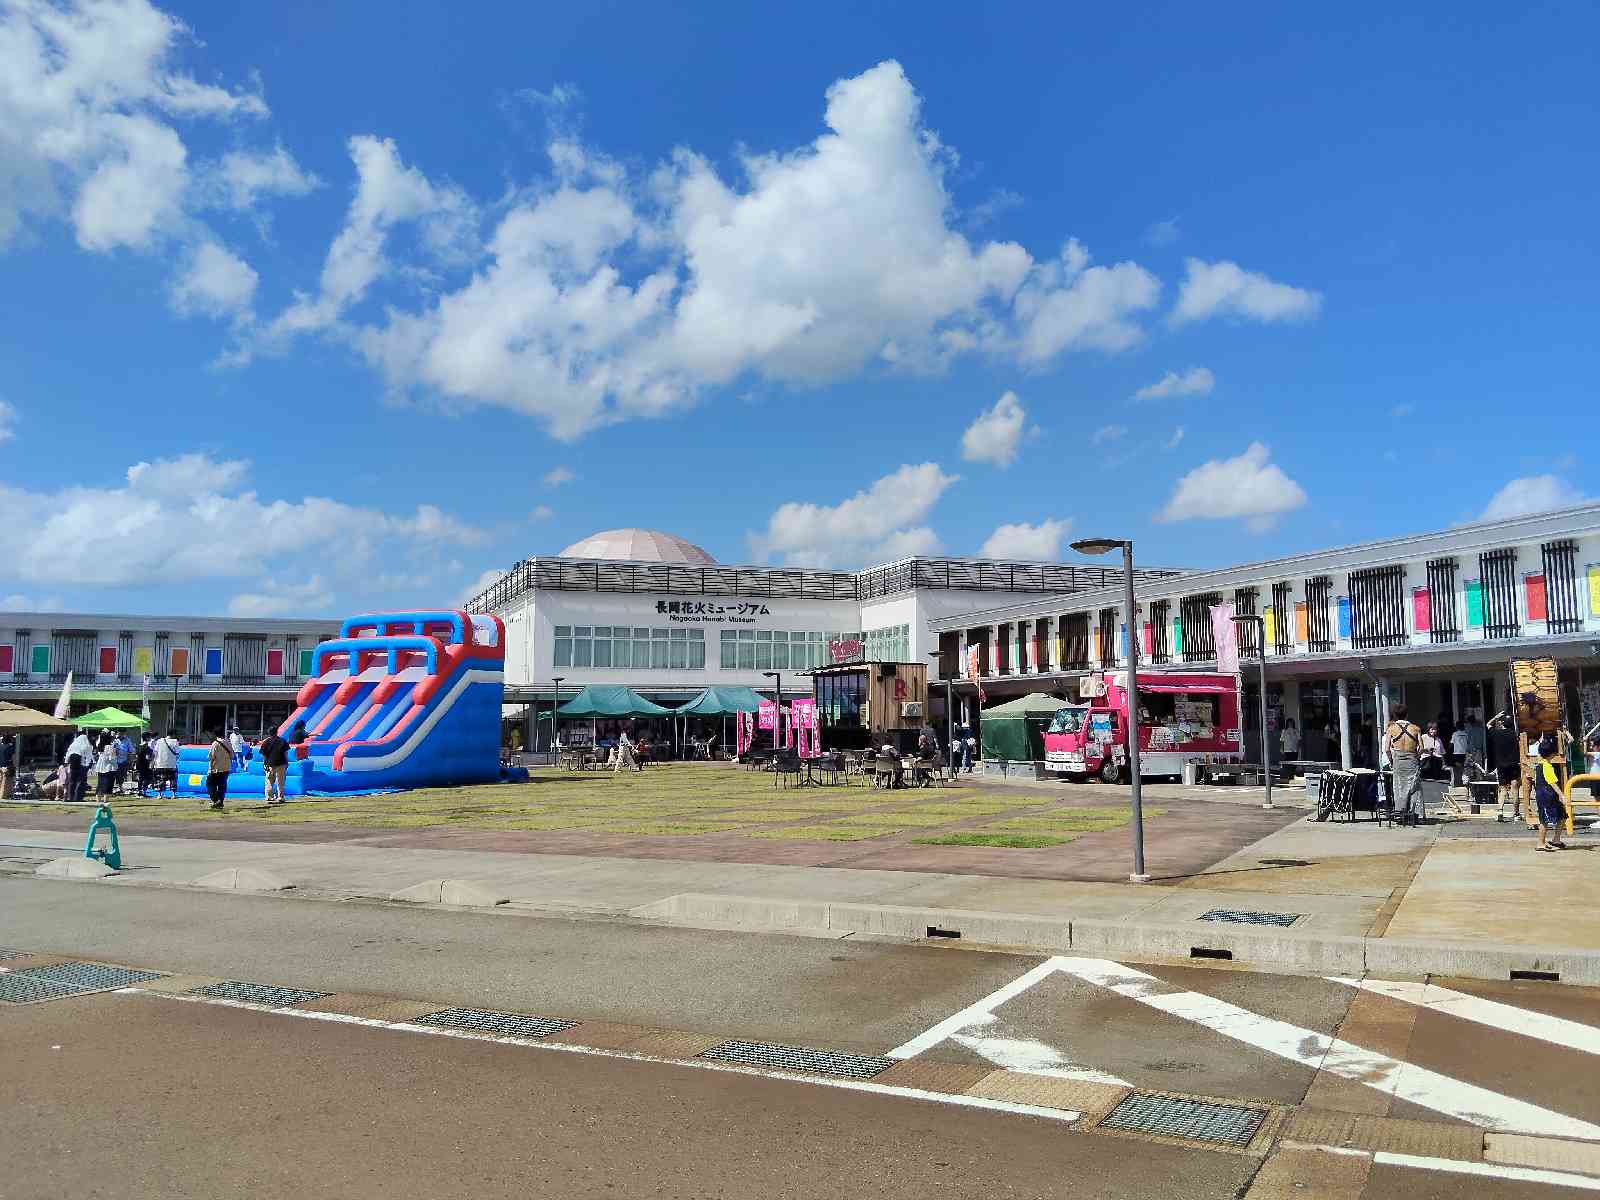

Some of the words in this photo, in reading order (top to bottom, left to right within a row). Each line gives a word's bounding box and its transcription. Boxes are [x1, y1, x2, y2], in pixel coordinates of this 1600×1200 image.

[655, 600, 770, 615] 長岡花火ミュージアム
